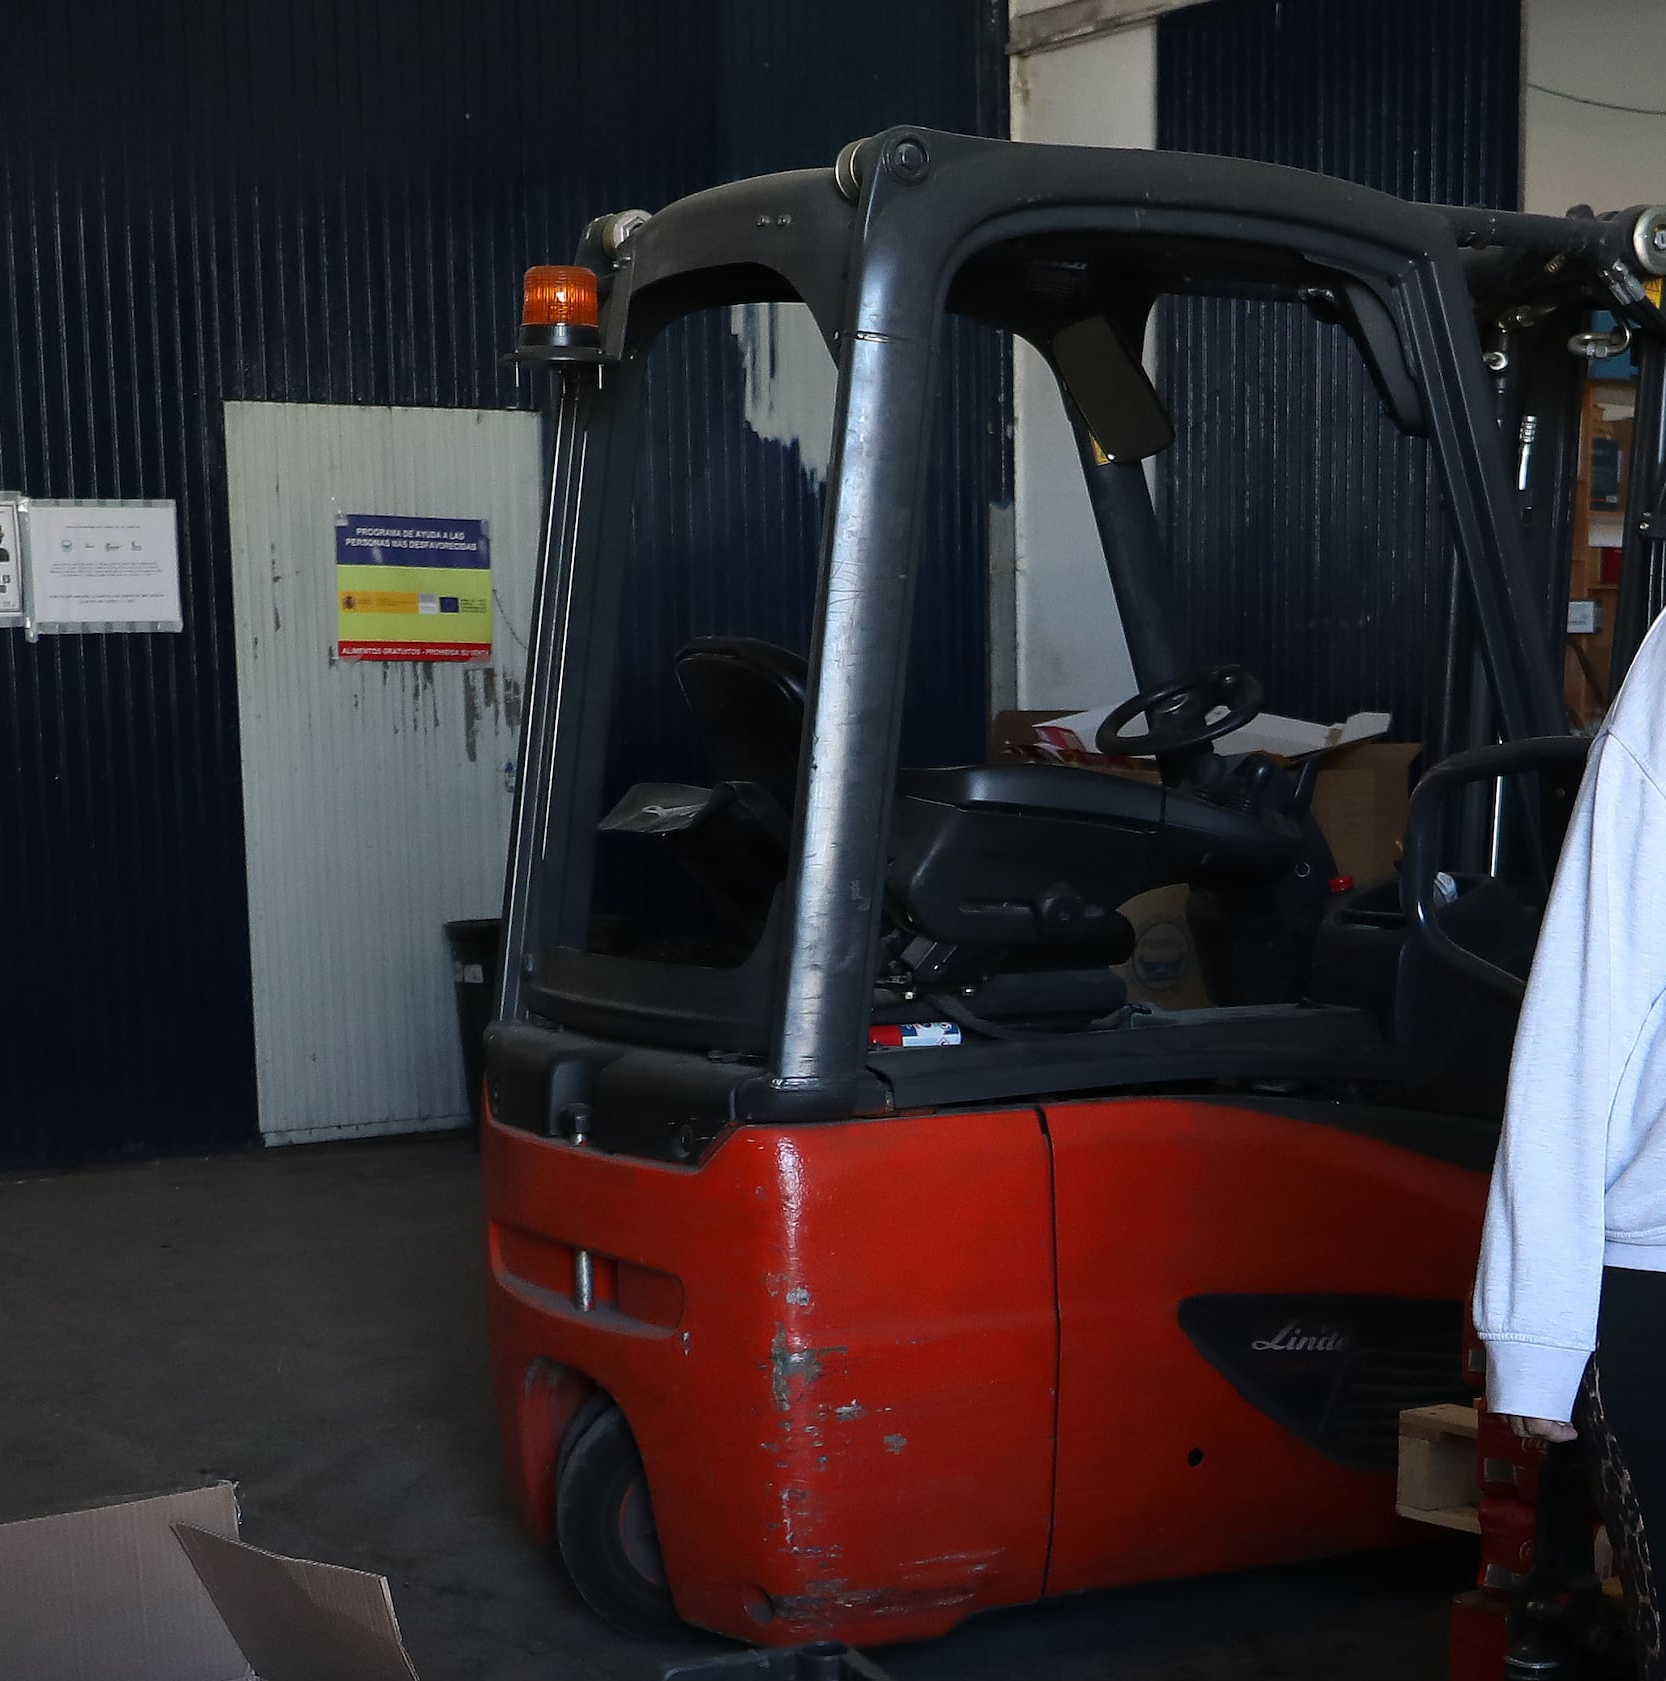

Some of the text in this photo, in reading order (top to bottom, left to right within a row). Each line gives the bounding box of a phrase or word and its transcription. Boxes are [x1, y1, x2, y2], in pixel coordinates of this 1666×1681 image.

[356, 527, 402, 538] PROGRAMA
[403, 529, 414, 538] DE
[415, 530, 441, 539] AYUDA
[1251, 1318, 1350, 1352] Linde
